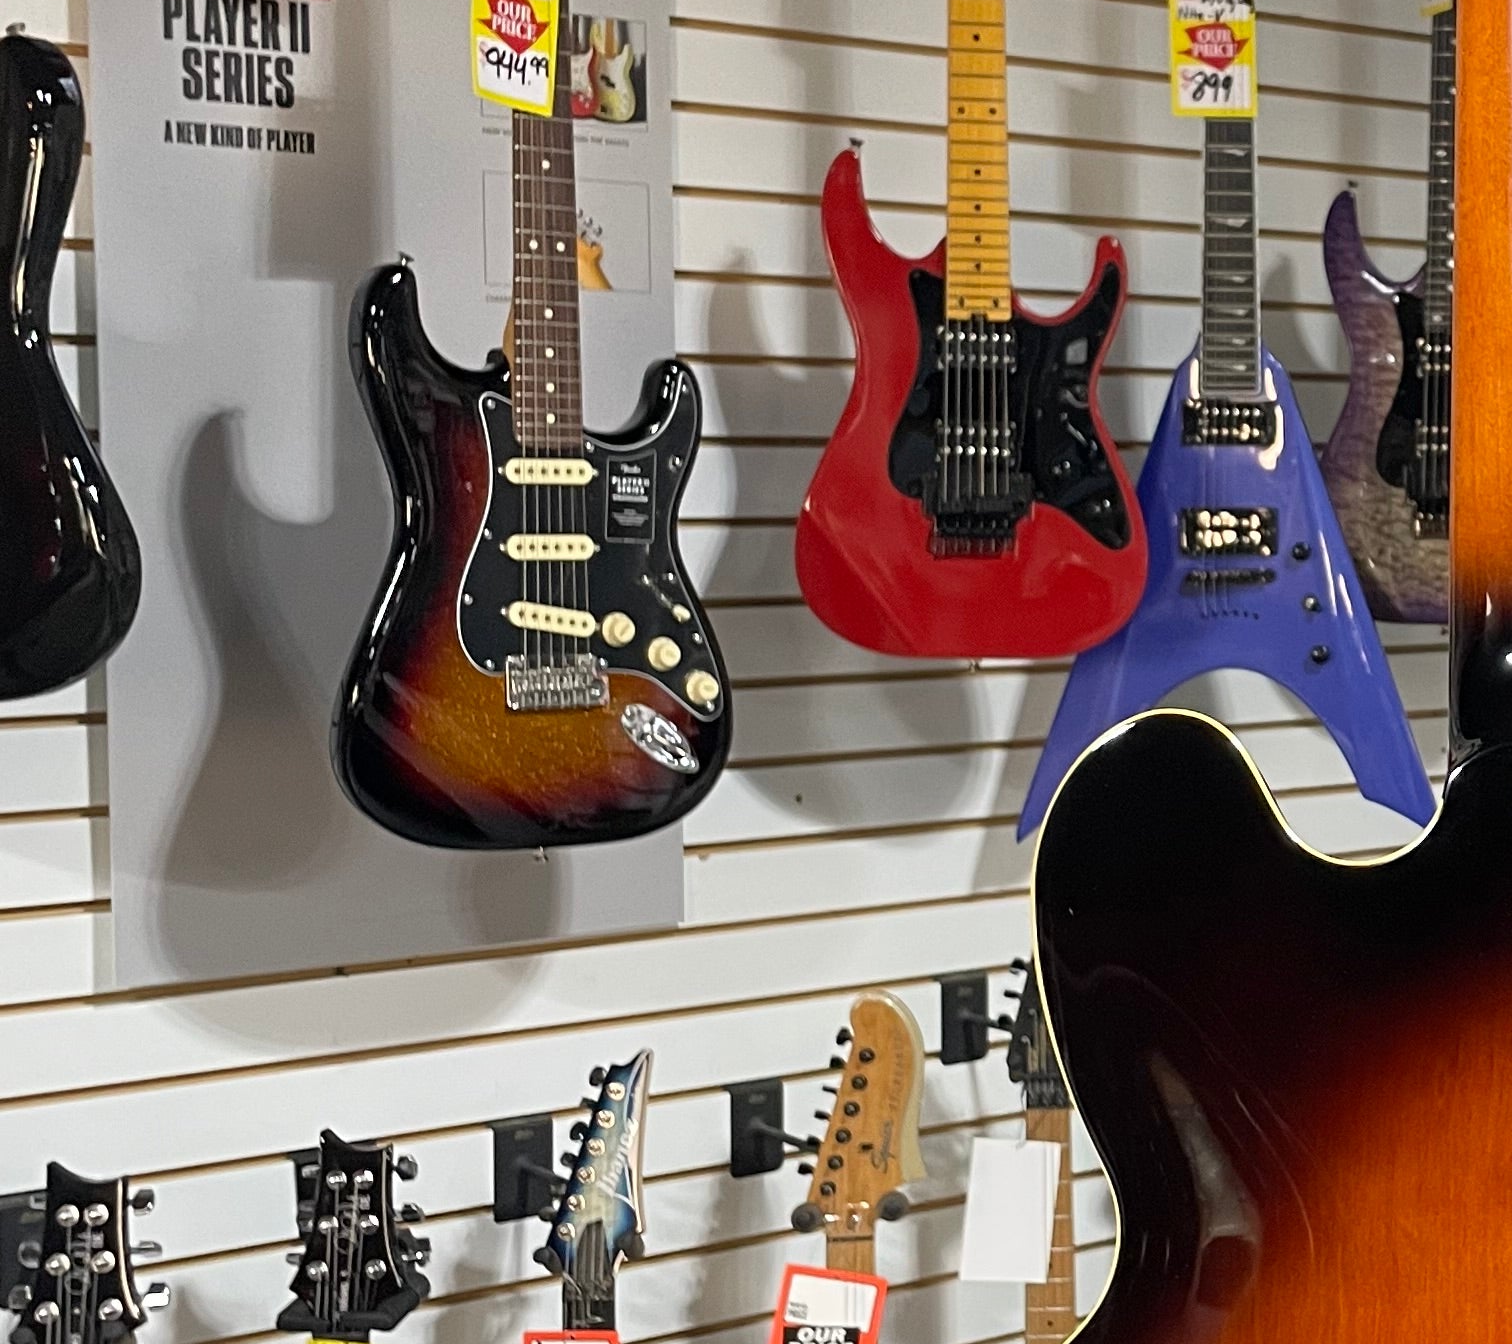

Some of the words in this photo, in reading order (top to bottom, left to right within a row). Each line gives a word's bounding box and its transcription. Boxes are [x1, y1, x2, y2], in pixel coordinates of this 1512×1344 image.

[289, 1, 311, 55] II
[491, 13, 538, 43] PRICE
[496, 0, 531, 25] OUR
[181, 46, 295, 109] SERIES
[164, 119, 174, 144] A
[176, 121, 207, 146] NEW
[210, 123, 243, 149] KIND
[246, 126, 262, 150] OF
[266, 128, 316, 154] PLAYER
[796, 1327, 847, 1344] OUR
